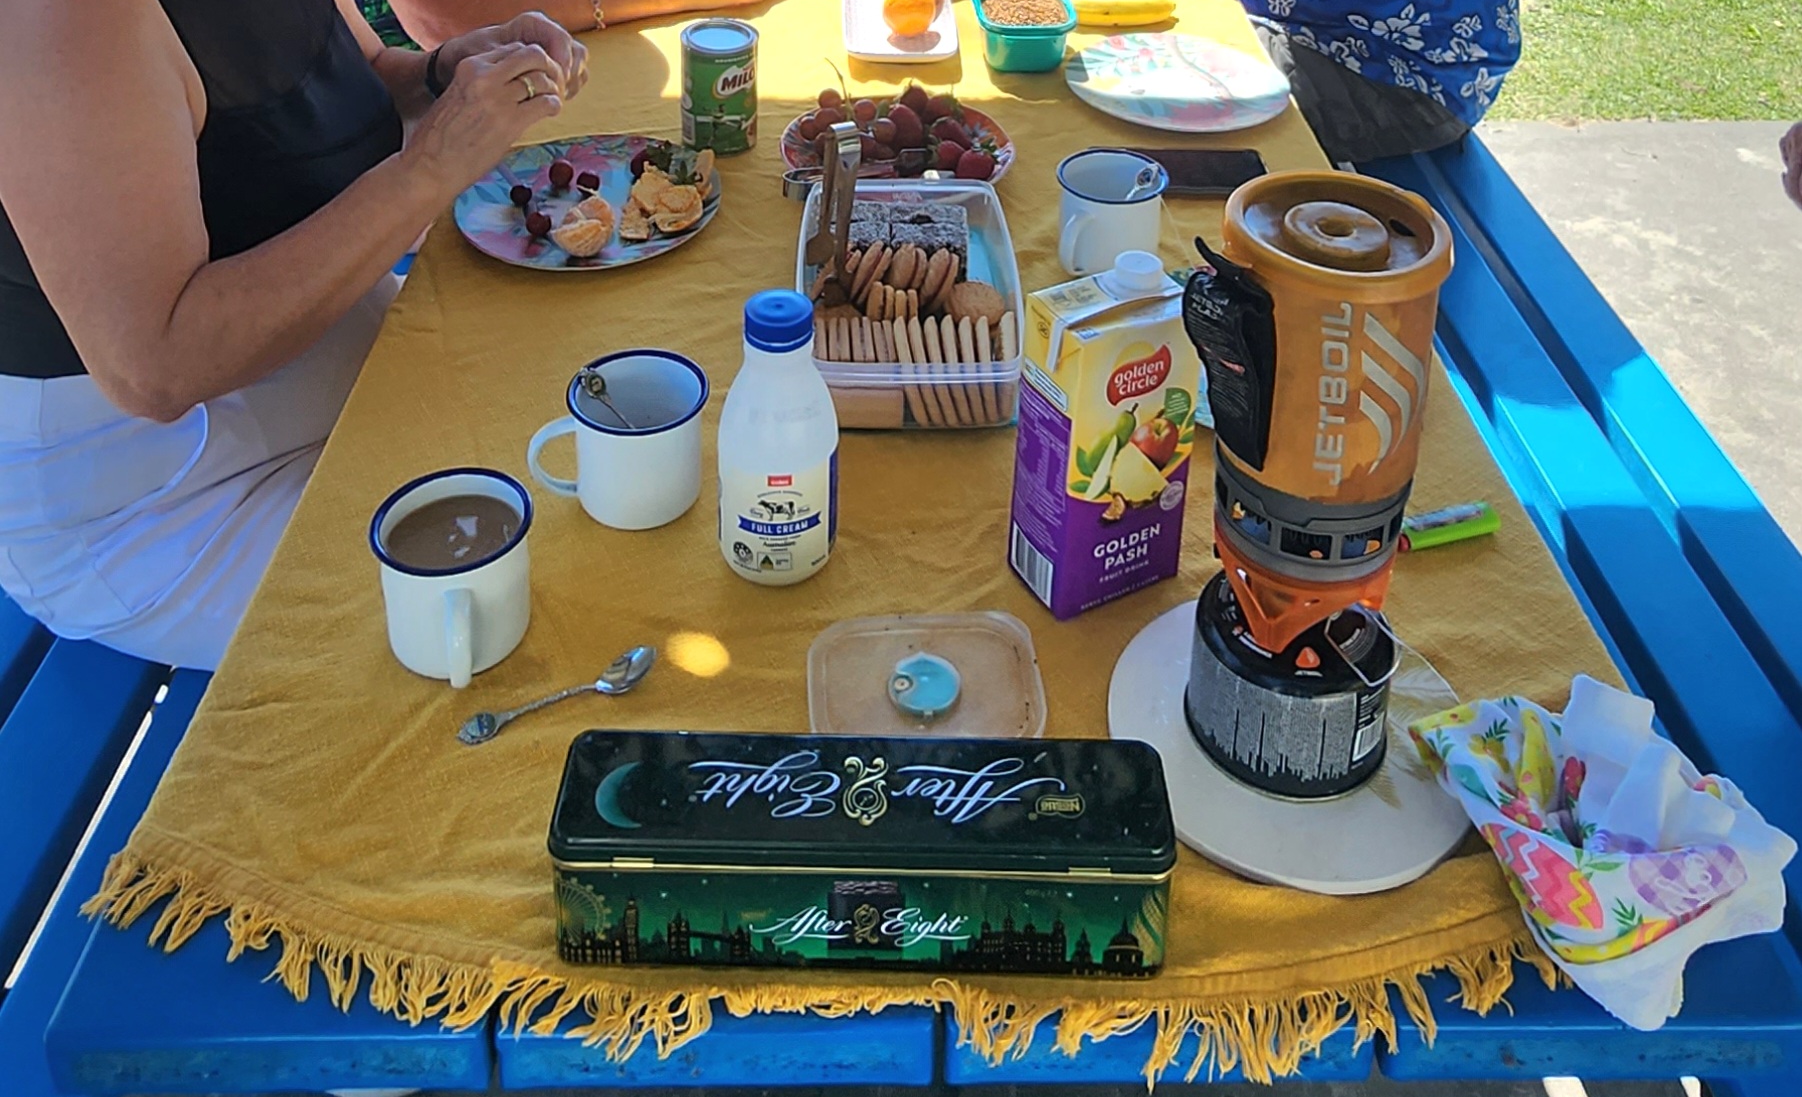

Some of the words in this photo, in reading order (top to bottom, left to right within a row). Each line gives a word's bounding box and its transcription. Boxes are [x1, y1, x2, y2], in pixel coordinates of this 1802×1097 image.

[721, 68, 755, 91] MILO
[1114, 360, 1164, 388] golden
[1118, 374, 1158, 395] circle
[1313, 302, 1353, 486] JETBOIL
[751, 522, 774, 534] FULL
[776, 520, 809, 534] CREAM
[1093, 523, 1161, 558] GOLDEN
[1105, 543, 1148, 570] PASH
[689, 751, 841, 818] Eight
[891, 758, 1065, 824] After
[749, 905, 852, 945] After
[880, 907, 971, 947] Eight
